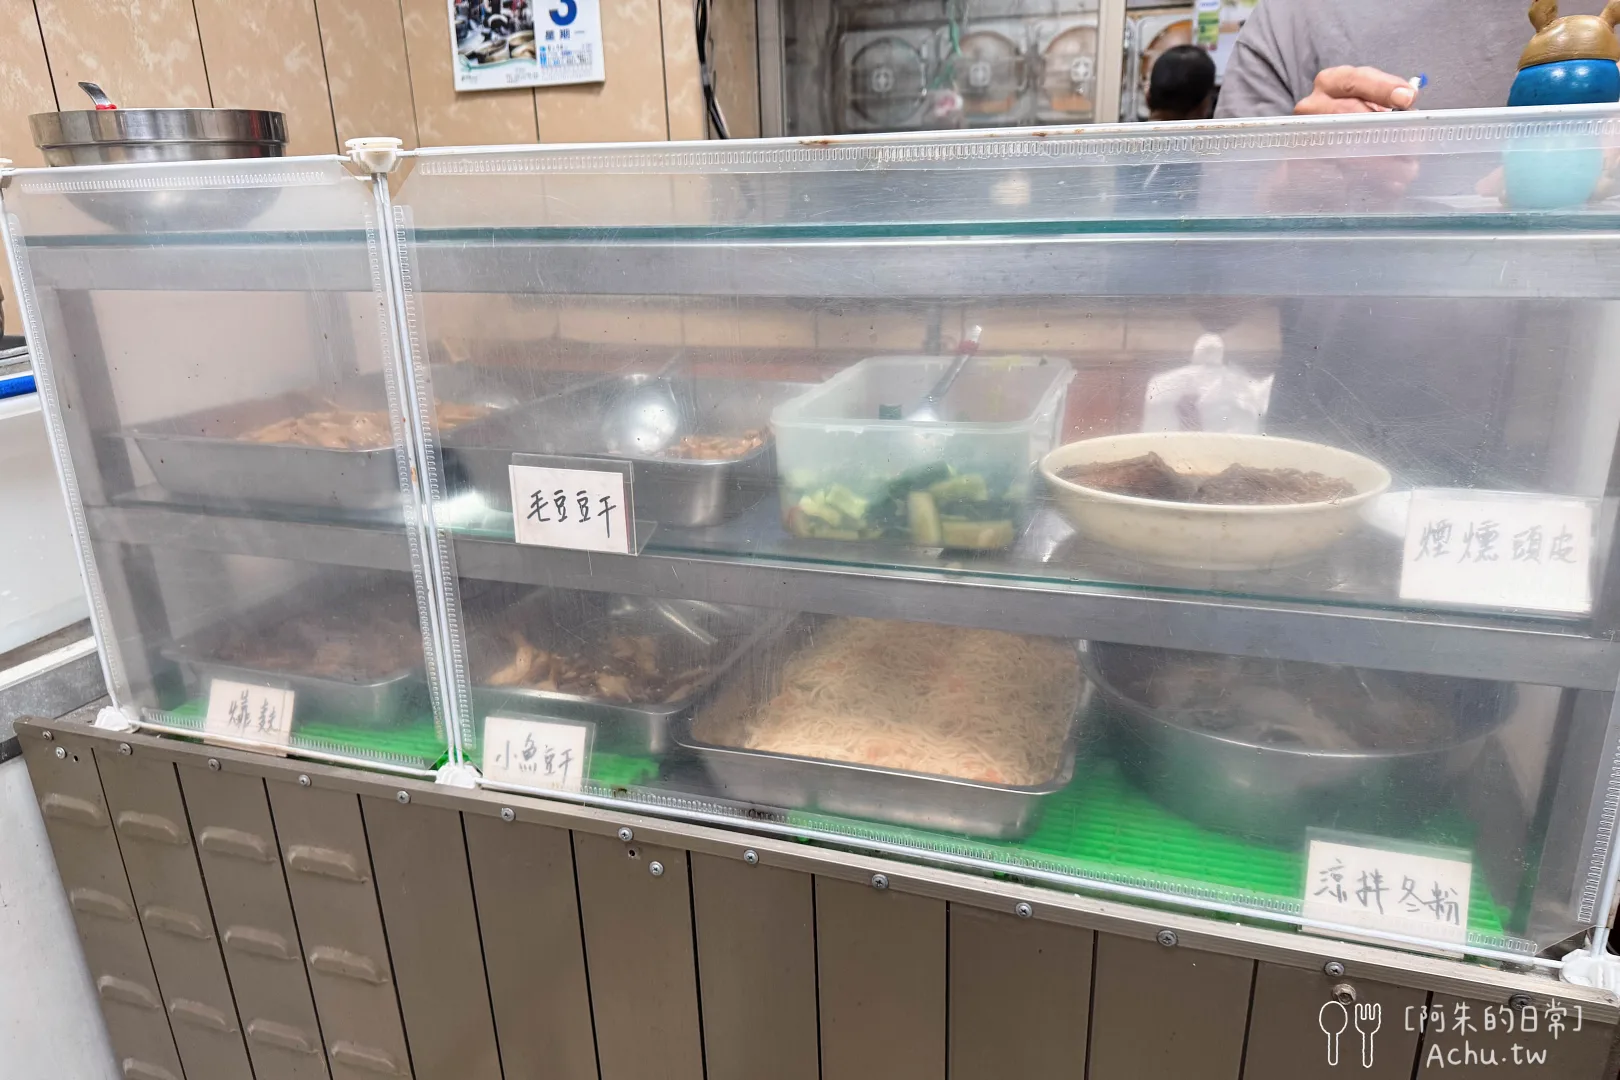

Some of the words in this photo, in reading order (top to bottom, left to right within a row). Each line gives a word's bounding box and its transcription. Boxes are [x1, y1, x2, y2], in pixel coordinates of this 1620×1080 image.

[527, 489, 617, 538] 毛豆豆干
[1414, 519, 1577, 564] 煙燻頭皮
[495, 732, 574, 784] 小魚豆干
[1313, 858, 1460, 926] 涼拌冬粉
